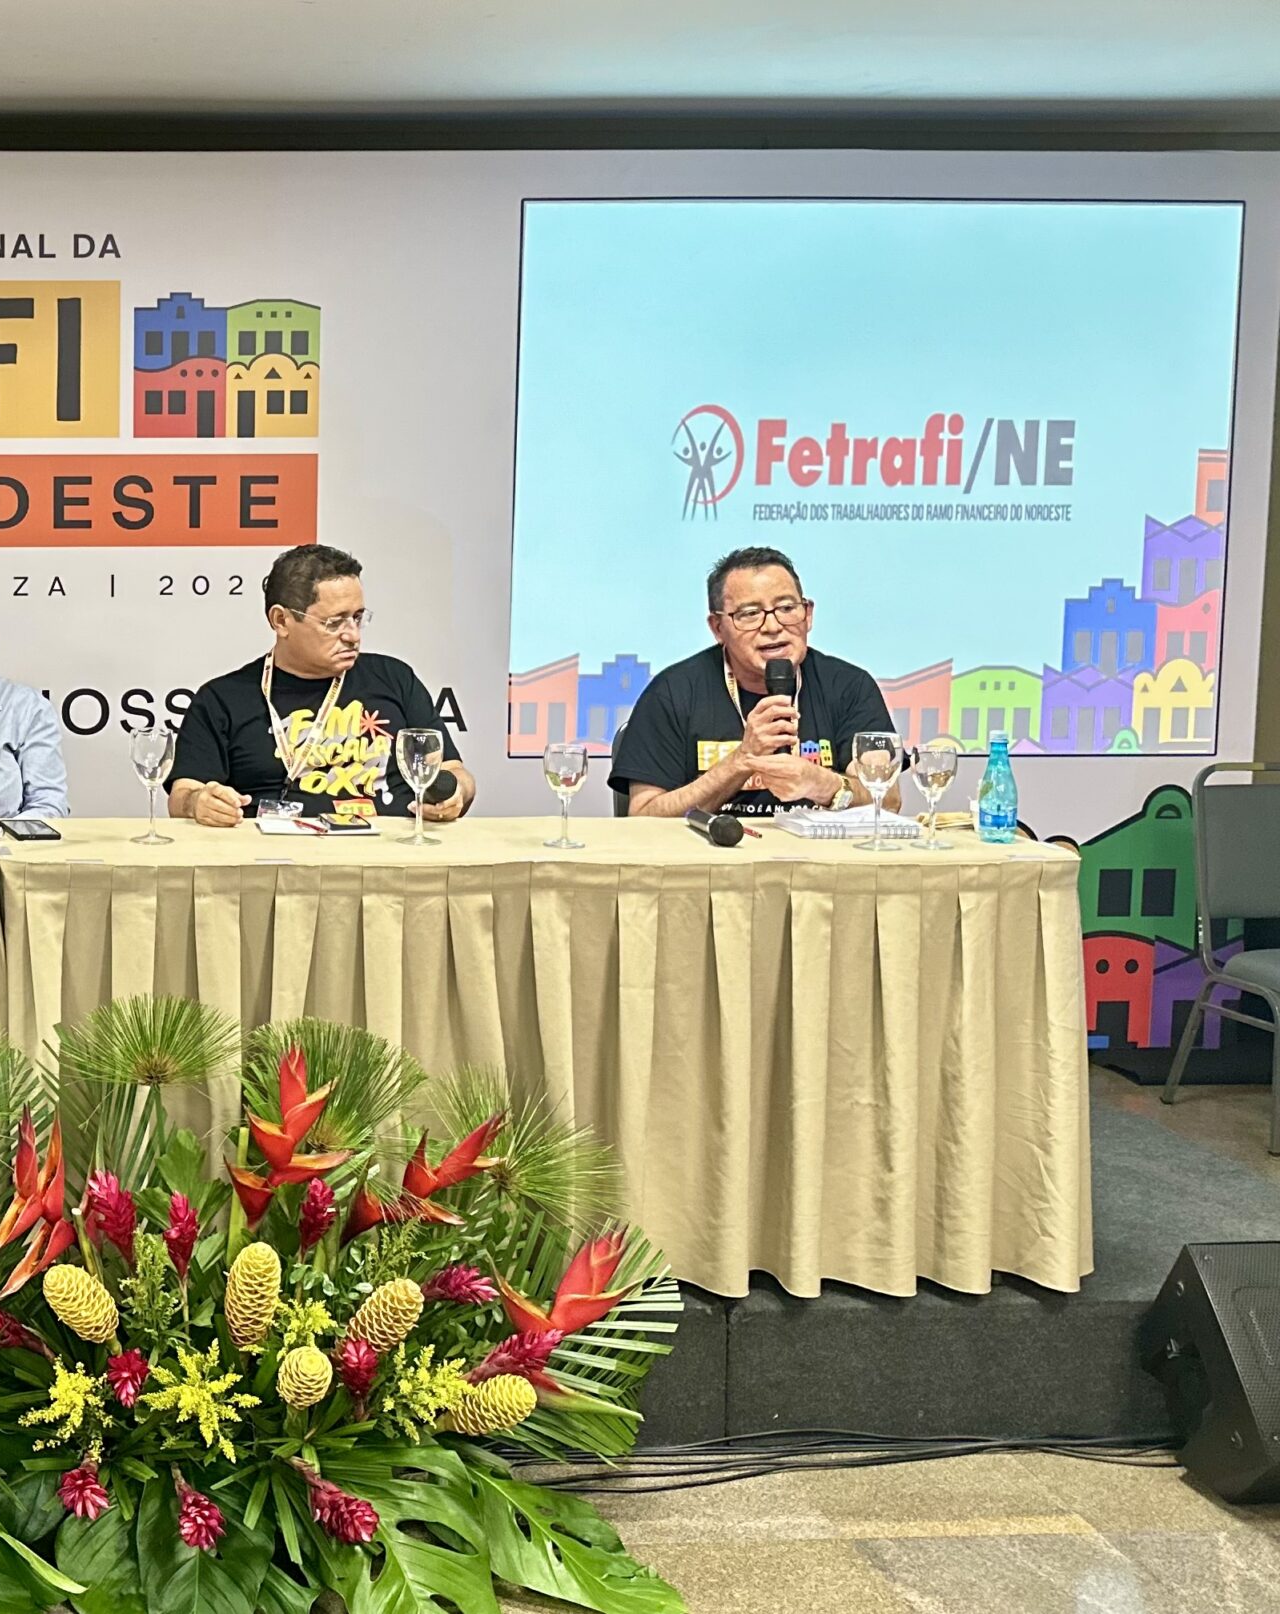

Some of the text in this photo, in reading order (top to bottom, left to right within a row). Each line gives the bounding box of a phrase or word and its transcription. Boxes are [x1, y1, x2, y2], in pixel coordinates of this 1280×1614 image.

[73, 233, 122, 259] DA
[755, 413, 1076, 495] Fetrafi/NE
[753, 501, 808, 525] FEDERAÇÃO
[810, 503, 829, 522] DOS
[831, 503, 910, 523] TRABALHADORES
[912, 504, 924, 522] DO
[926, 504, 953, 522] RAMO
[955, 504, 1009, 522] FINANCEIRO
[1010, 504, 1023, 522] DO
